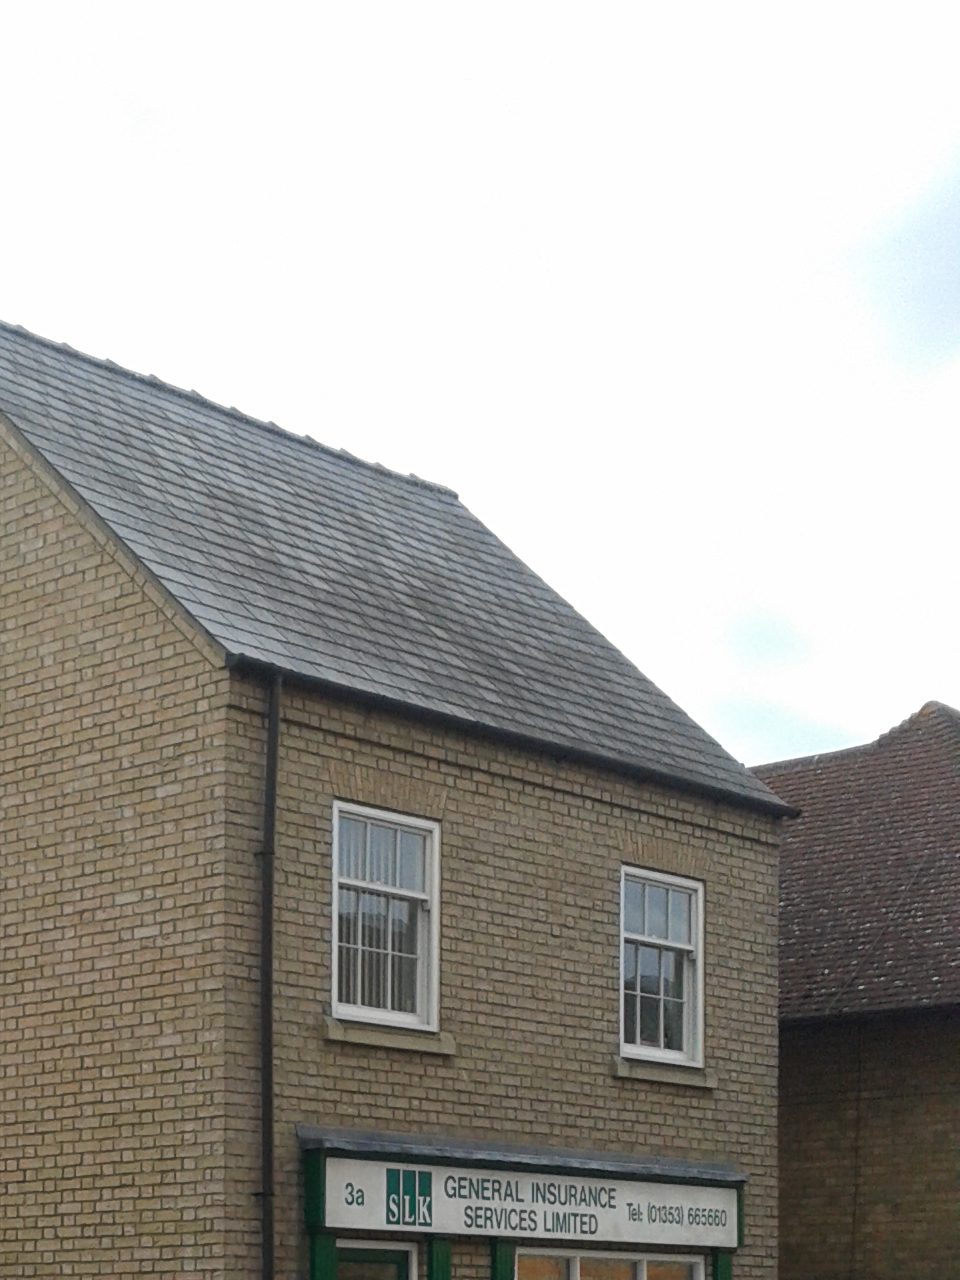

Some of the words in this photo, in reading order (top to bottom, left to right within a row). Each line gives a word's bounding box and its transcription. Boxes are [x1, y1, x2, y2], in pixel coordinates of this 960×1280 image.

[344, 1182, 365, 1206] 3a
[444, 1175, 524, 1203] GENERAL
[531, 1182, 617, 1209] INSURANCE
[388, 1193, 432, 1225] SLK
[464, 1205, 538, 1231] SERVICES
[544, 1210, 599, 1235] LIMITED
[626, 1203, 643, 1222] Tel:
[647, 1202, 684, 1228] (01353)
[687, 1206, 728, 1228] 665660
